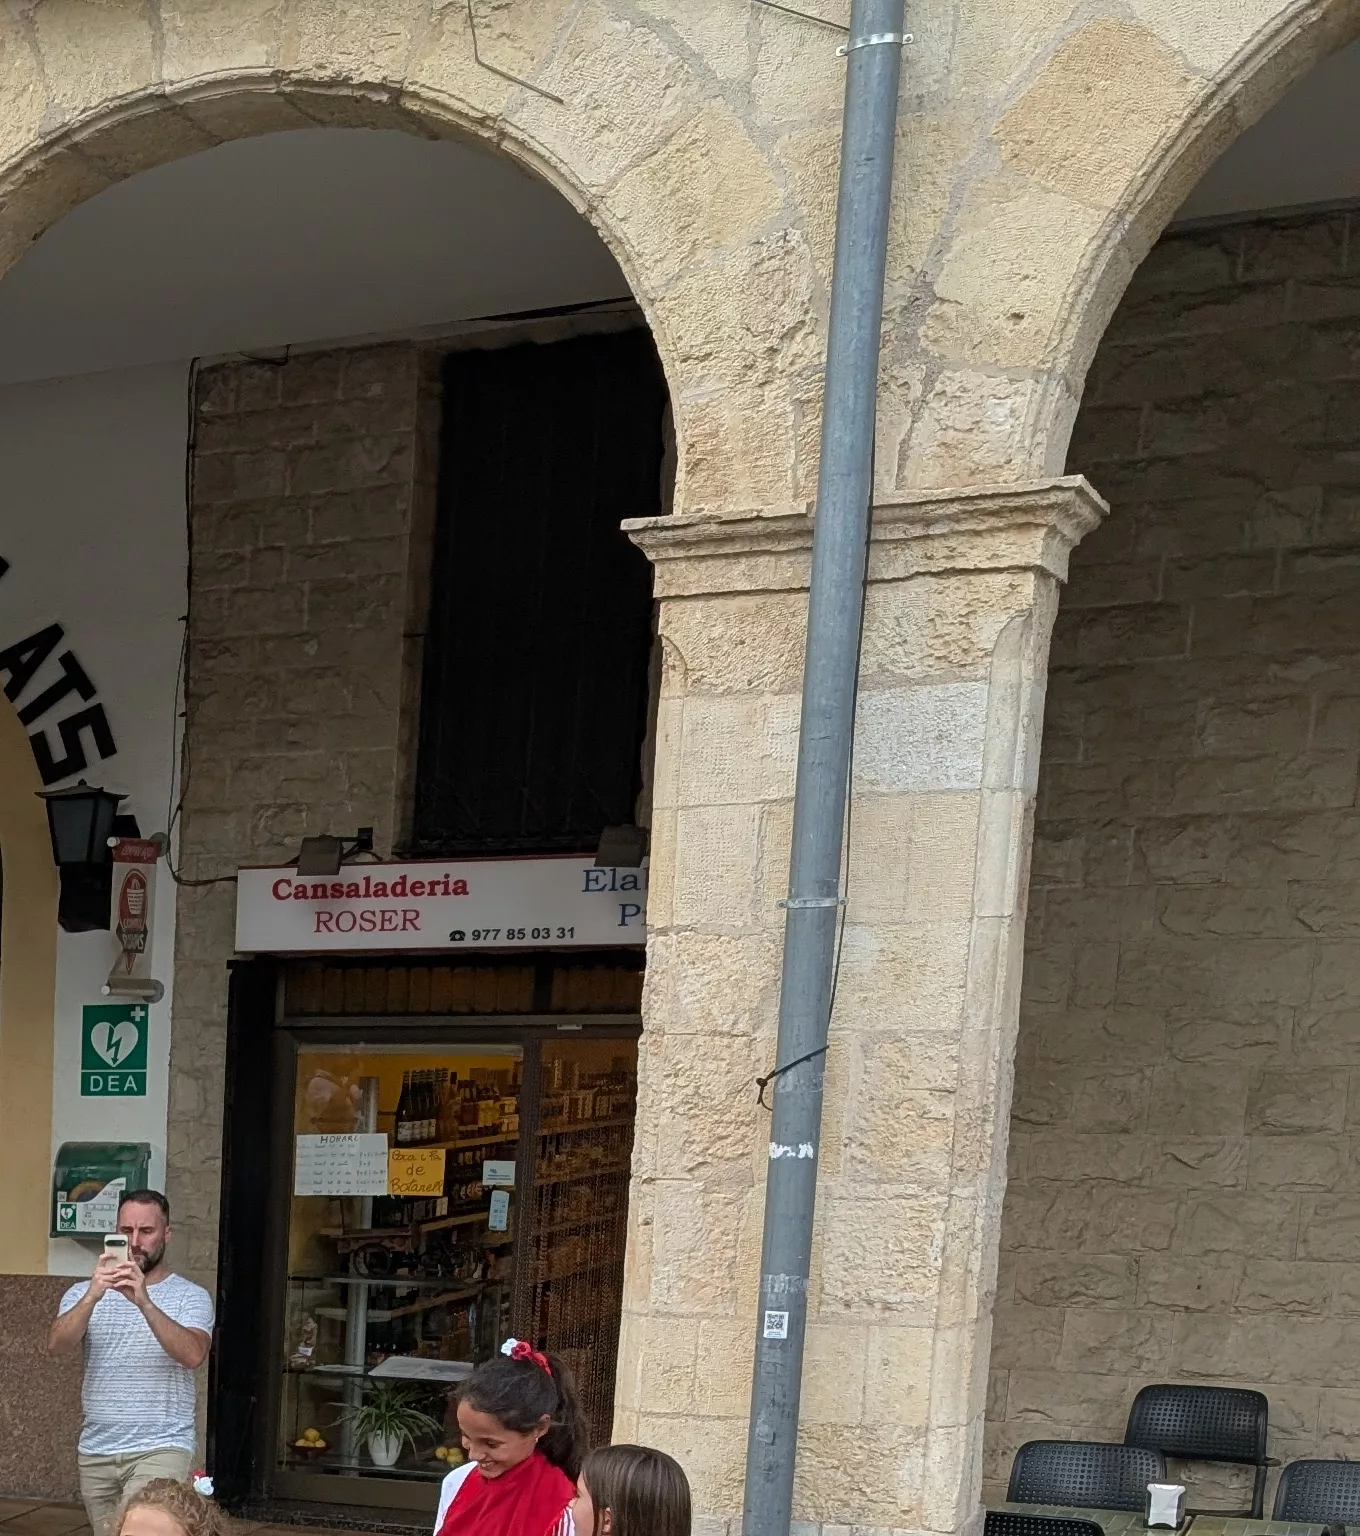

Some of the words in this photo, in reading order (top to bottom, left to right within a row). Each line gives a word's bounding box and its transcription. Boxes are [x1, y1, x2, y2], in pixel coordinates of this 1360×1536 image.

[271, 873, 470, 900] Cansaladeria
[581, 867, 649, 892] Ela
[313, 909, 422, 933] ROSER
[471, 929, 499, 942] 977
[506, 928, 527, 941] 85
[530, 927, 552, 940] 03
[556, 926, 576, 939] 31
[90, 1075, 138, 1092] DEA
[406, 1163, 426, 1176] de
